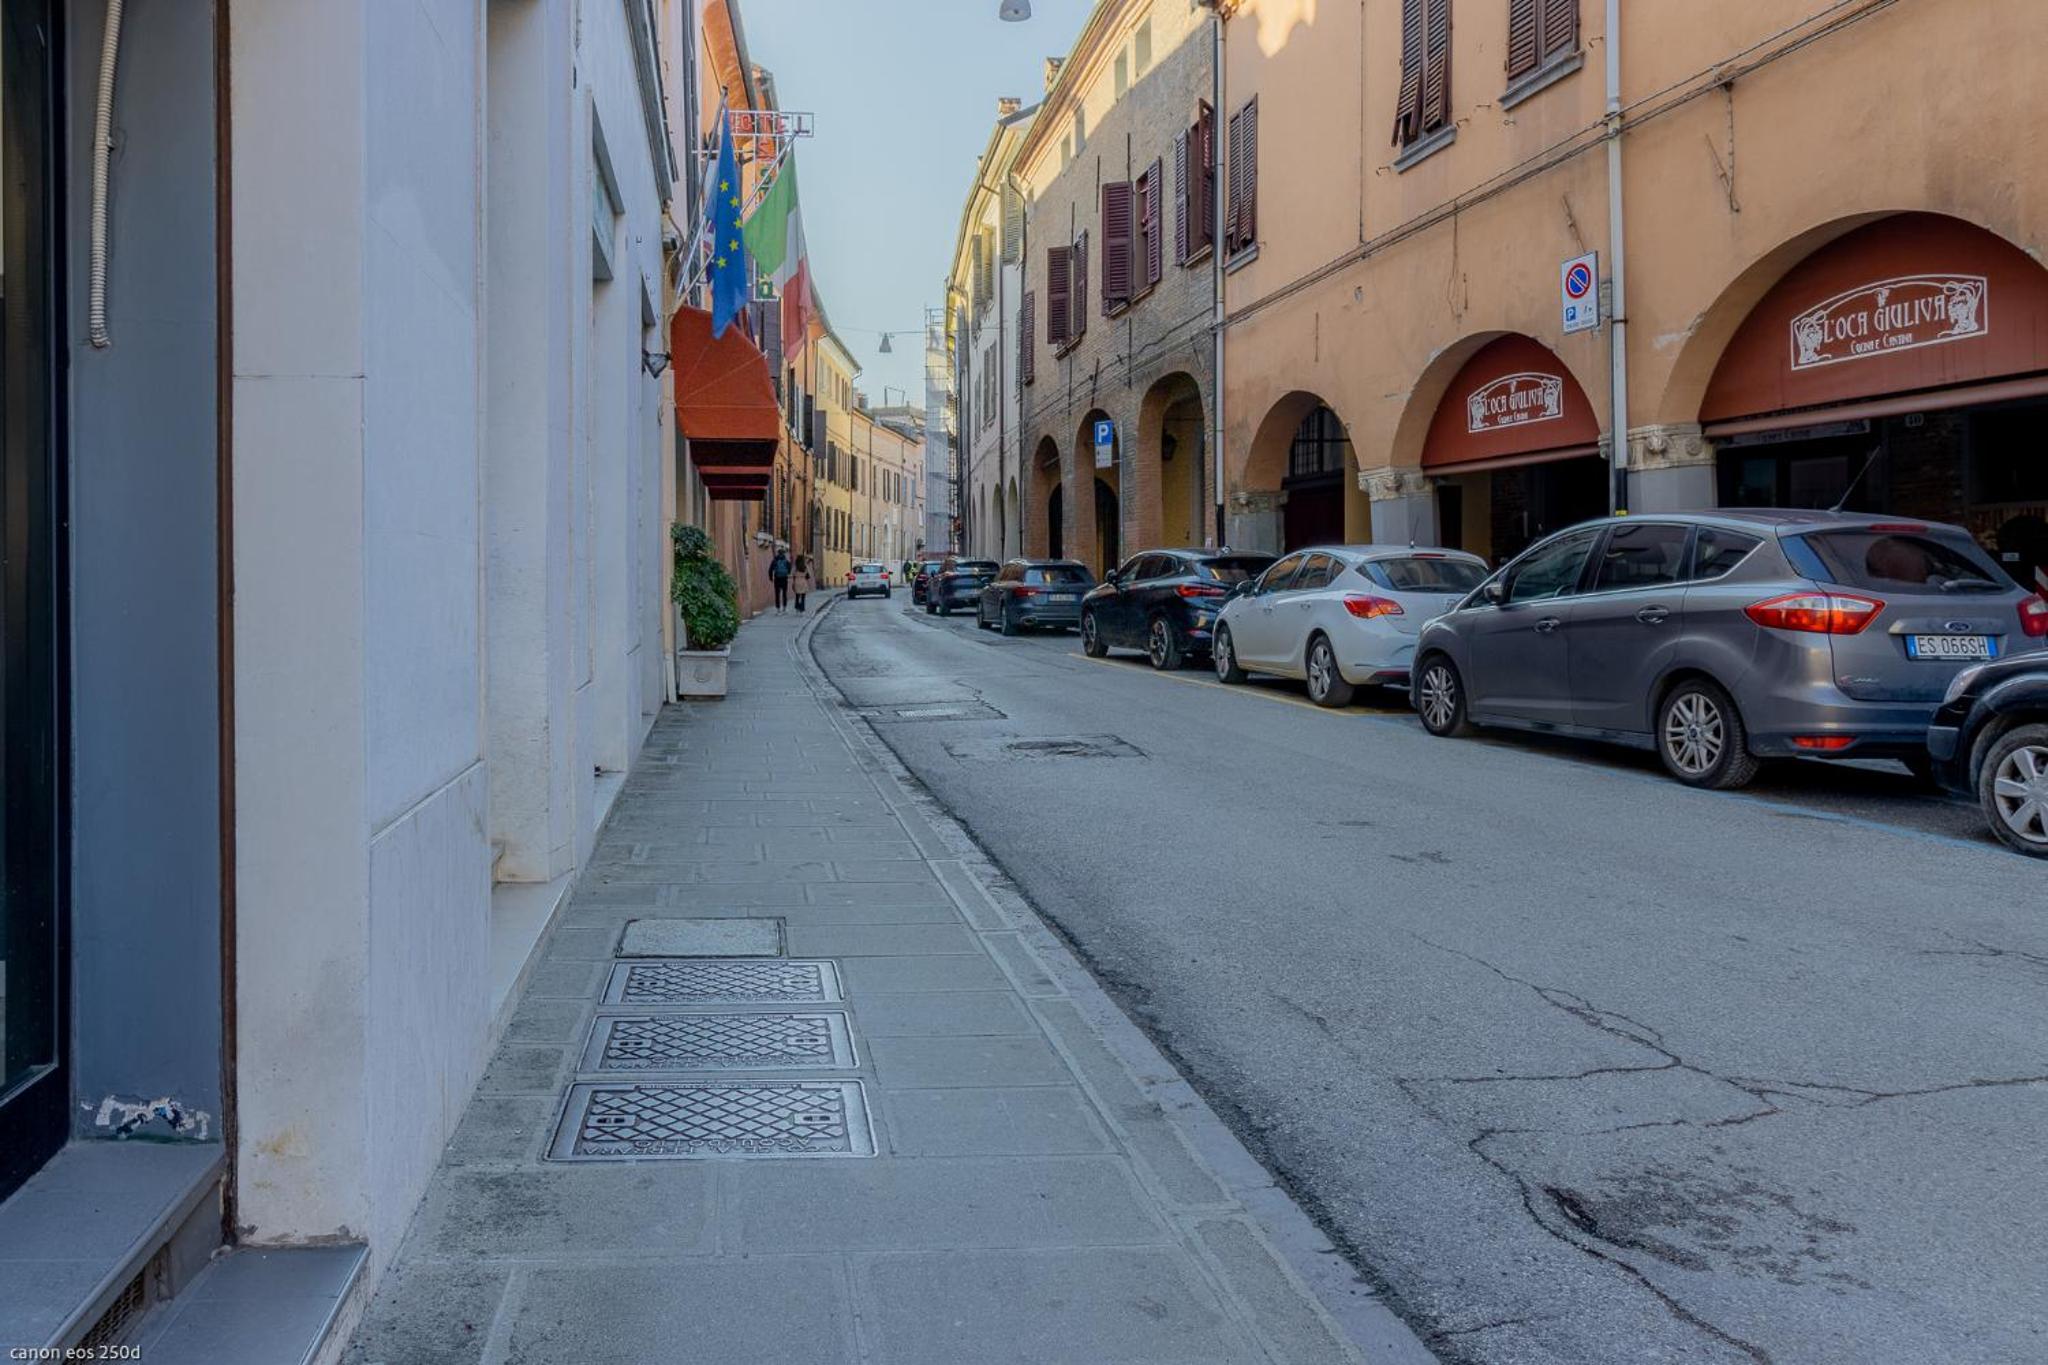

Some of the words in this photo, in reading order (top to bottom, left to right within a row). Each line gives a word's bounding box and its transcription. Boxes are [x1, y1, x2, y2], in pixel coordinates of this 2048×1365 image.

[1823, 311, 1869, 343] L'OCA
[1874, 294, 1946, 332] GIULIVA
[1098, 424, 1109, 443] P
[1917, 636, 1938, 654] ES
[1942, 637, 1987, 655] 066SH
